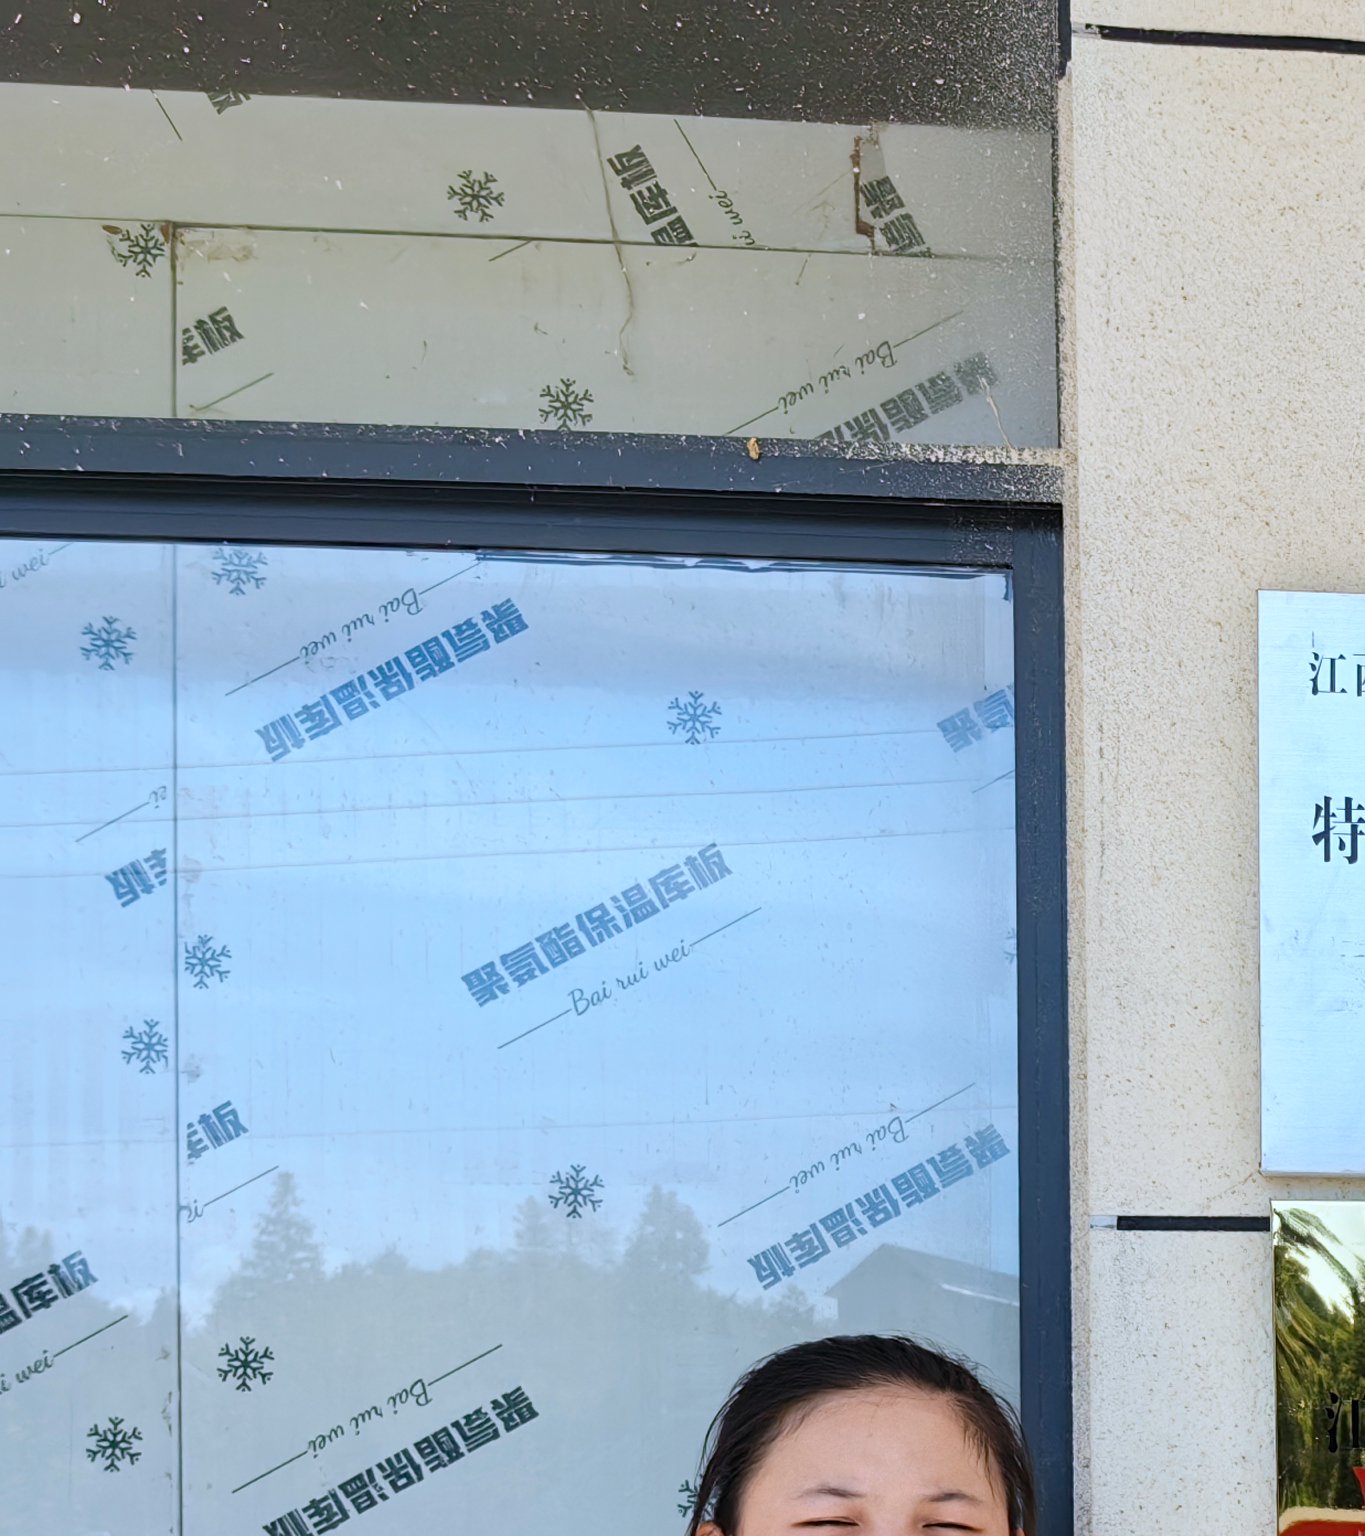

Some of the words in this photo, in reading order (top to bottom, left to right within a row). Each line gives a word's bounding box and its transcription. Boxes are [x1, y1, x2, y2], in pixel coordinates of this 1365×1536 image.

[855, 341, 898, 375] Bai
[778, 382, 814, 414] wei
[379, 587, 423, 623] Bai
[341, 613, 376, 643] rui
[299, 631, 337, 665] wei
[255, 598, 529, 762] 聚氨酯保温库板
[461, 842, 734, 1007] 聚氨酯保温库板
[567, 980, 612, 1016] Bai
[616, 961, 649, 991] rui
[653, 938, 692, 972] wei
[866, 1116, 910, 1151] Bai
[830, 1142, 862, 1171] rui
[789, 1161, 825, 1194] wei
[747, 1123, 1011, 1290] 聚氨酯保温库板
[16, 1349, 54, 1383] wei
[386, 1379, 432, 1415] Bai
[350, 1406, 383, 1436] rui
[307, 1425, 345, 1459] wei
